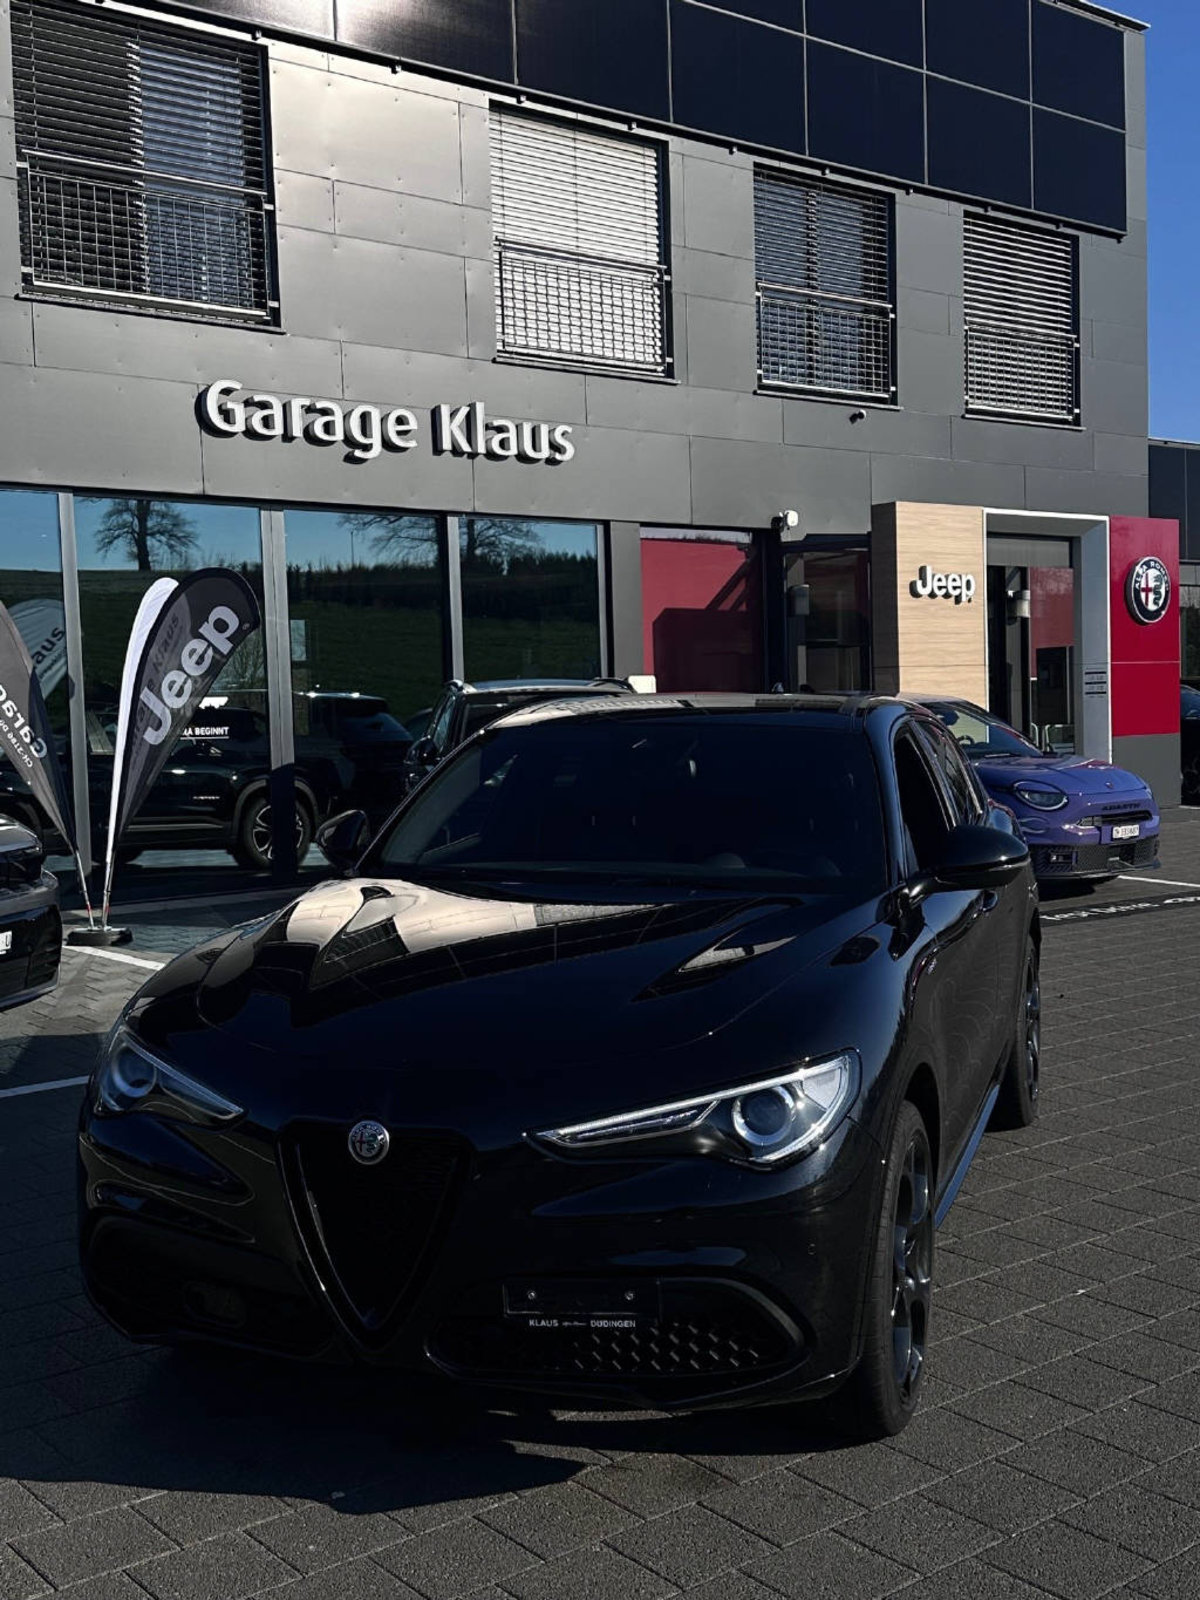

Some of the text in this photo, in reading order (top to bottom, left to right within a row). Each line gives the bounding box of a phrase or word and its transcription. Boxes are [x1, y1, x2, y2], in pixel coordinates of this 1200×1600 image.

[199, 379, 575, 463] Garage Klaus
[913, 565, 976, 603] Jeep
[32, 627, 65, 670] aus
[140, 605, 240, 745] Jeep
[194, 726, 230, 736] BEGINNT
[529, 1319, 559, 1328] KLAUS
